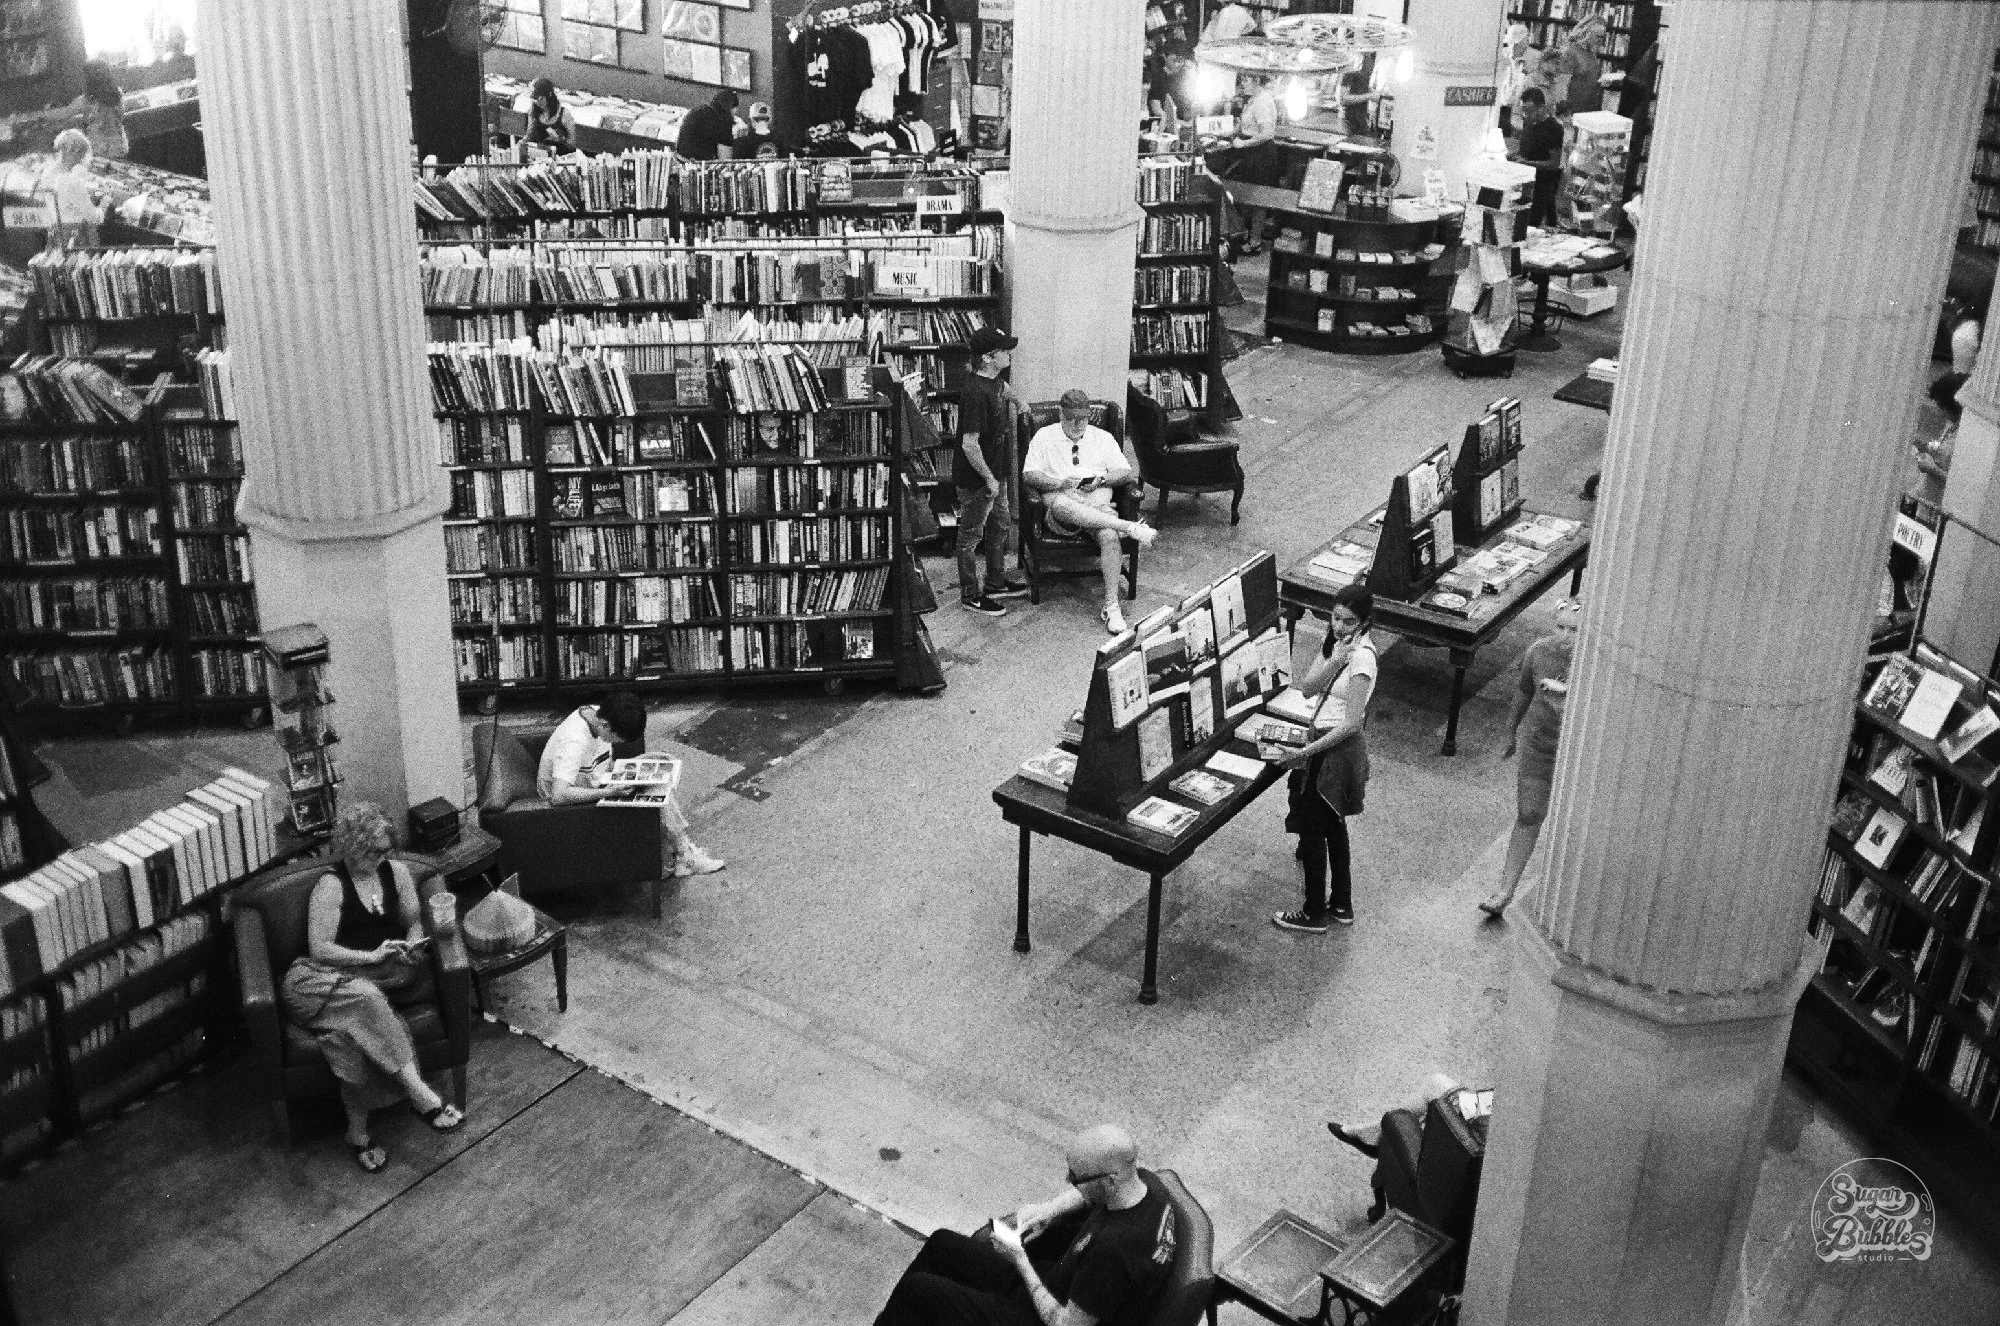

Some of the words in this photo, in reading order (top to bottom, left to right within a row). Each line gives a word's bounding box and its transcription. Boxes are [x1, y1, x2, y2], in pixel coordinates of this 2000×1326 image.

[926, 199, 953, 212] DRAMA
[892, 272, 918, 285] MUSIC
[1896, 522, 1924, 550] POETRY
